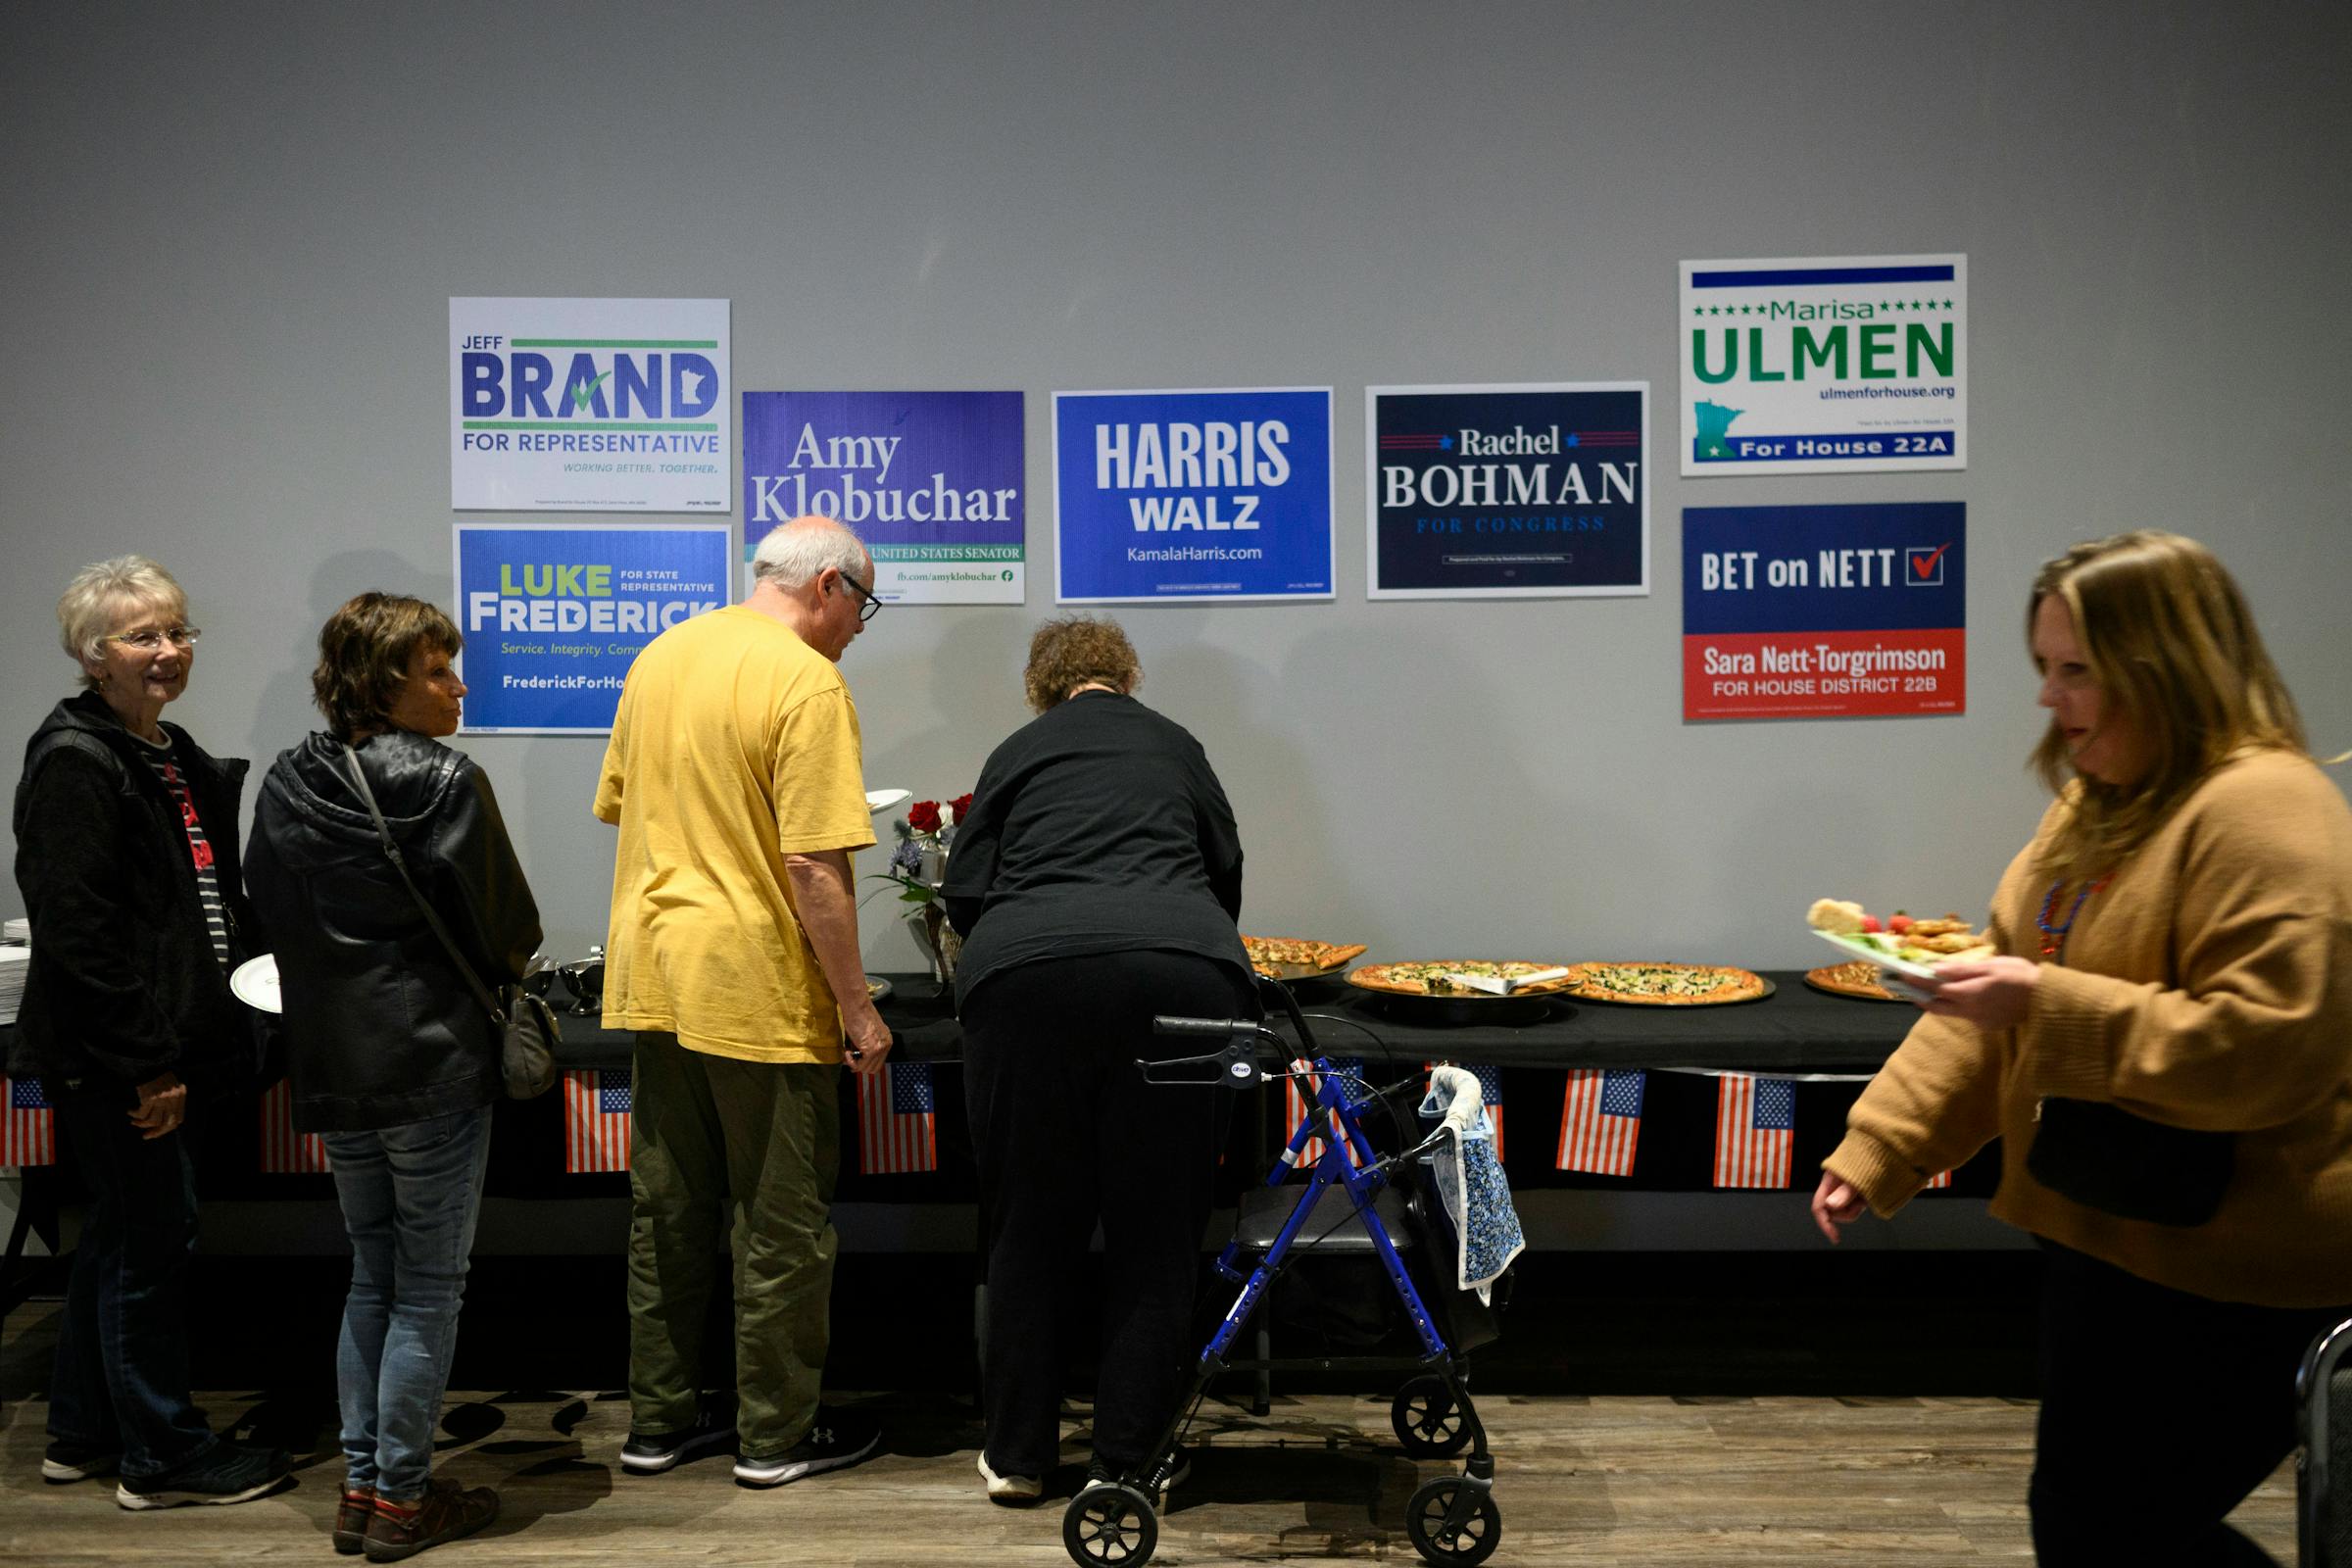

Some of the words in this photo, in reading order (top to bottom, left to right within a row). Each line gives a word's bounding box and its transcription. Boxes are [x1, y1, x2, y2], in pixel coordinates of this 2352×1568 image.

[1770, 299, 1875, 320] Marisa
[462, 336, 503, 350] JEFF
[1692, 322, 1953, 384] ULMEN
[462, 353, 718, 418] BRAND
[1820, 386, 1955, 401] ulmenforhouse.org
[464, 433, 509, 451] FOR
[518, 434, 719, 453] REPRESENTATIVE
[1458, 425, 1560, 456] Rachel
[1740, 442, 1786, 457] For
[1796, 439, 1883, 456] House
[1894, 437, 1947, 453] 22A
[787, 422, 902, 484] Amy
[1096, 420, 1291, 489] HARRIS
[564, 464, 613, 473] WORKING
[616, 464, 656, 473] BETTER.
[660, 465, 718, 474] TOGETHER.
[1382, 463, 1639, 508] BOHMAN
[752, 473, 1016, 521] Klobuchar
[1129, 496, 1260, 531] WALZ
[1416, 517, 1462, 534] FOR
[1475, 515, 1605, 533] CONGRESS
[871, 548, 918, 560] UNITED
[920, 548, 963, 560] STATES
[965, 547, 1020, 560] SENATOR
[1127, 546, 1262, 562] KamalaHarris.com
[620, 570, 643, 579] FOR
[646, 570, 678, 579] STATE
[897, 571, 997, 583] fb.com/amyklobuchar
[1702, 553, 1758, 590] BET
[1768, 559, 1808, 587] on
[1819, 549, 1895, 588] NETT
[501, 564, 612, 597] LUKE
[620, 583, 714, 592] REPRESENTATIVE
[501, 643, 547, 655] Service.
[551, 643, 604, 658] Integrity.
[1704, 647, 1755, 675] Sara
[1762, 644, 1945, 677] Nett-Torgrimson
[503, 675, 624, 689] FrederickForHo
[1714, 681, 1748, 697] FOR
[1754, 679, 1815, 696] HOUSE
[1822, 677, 1897, 695] DISTRICT
[1904, 676, 1936, 693] 22B
